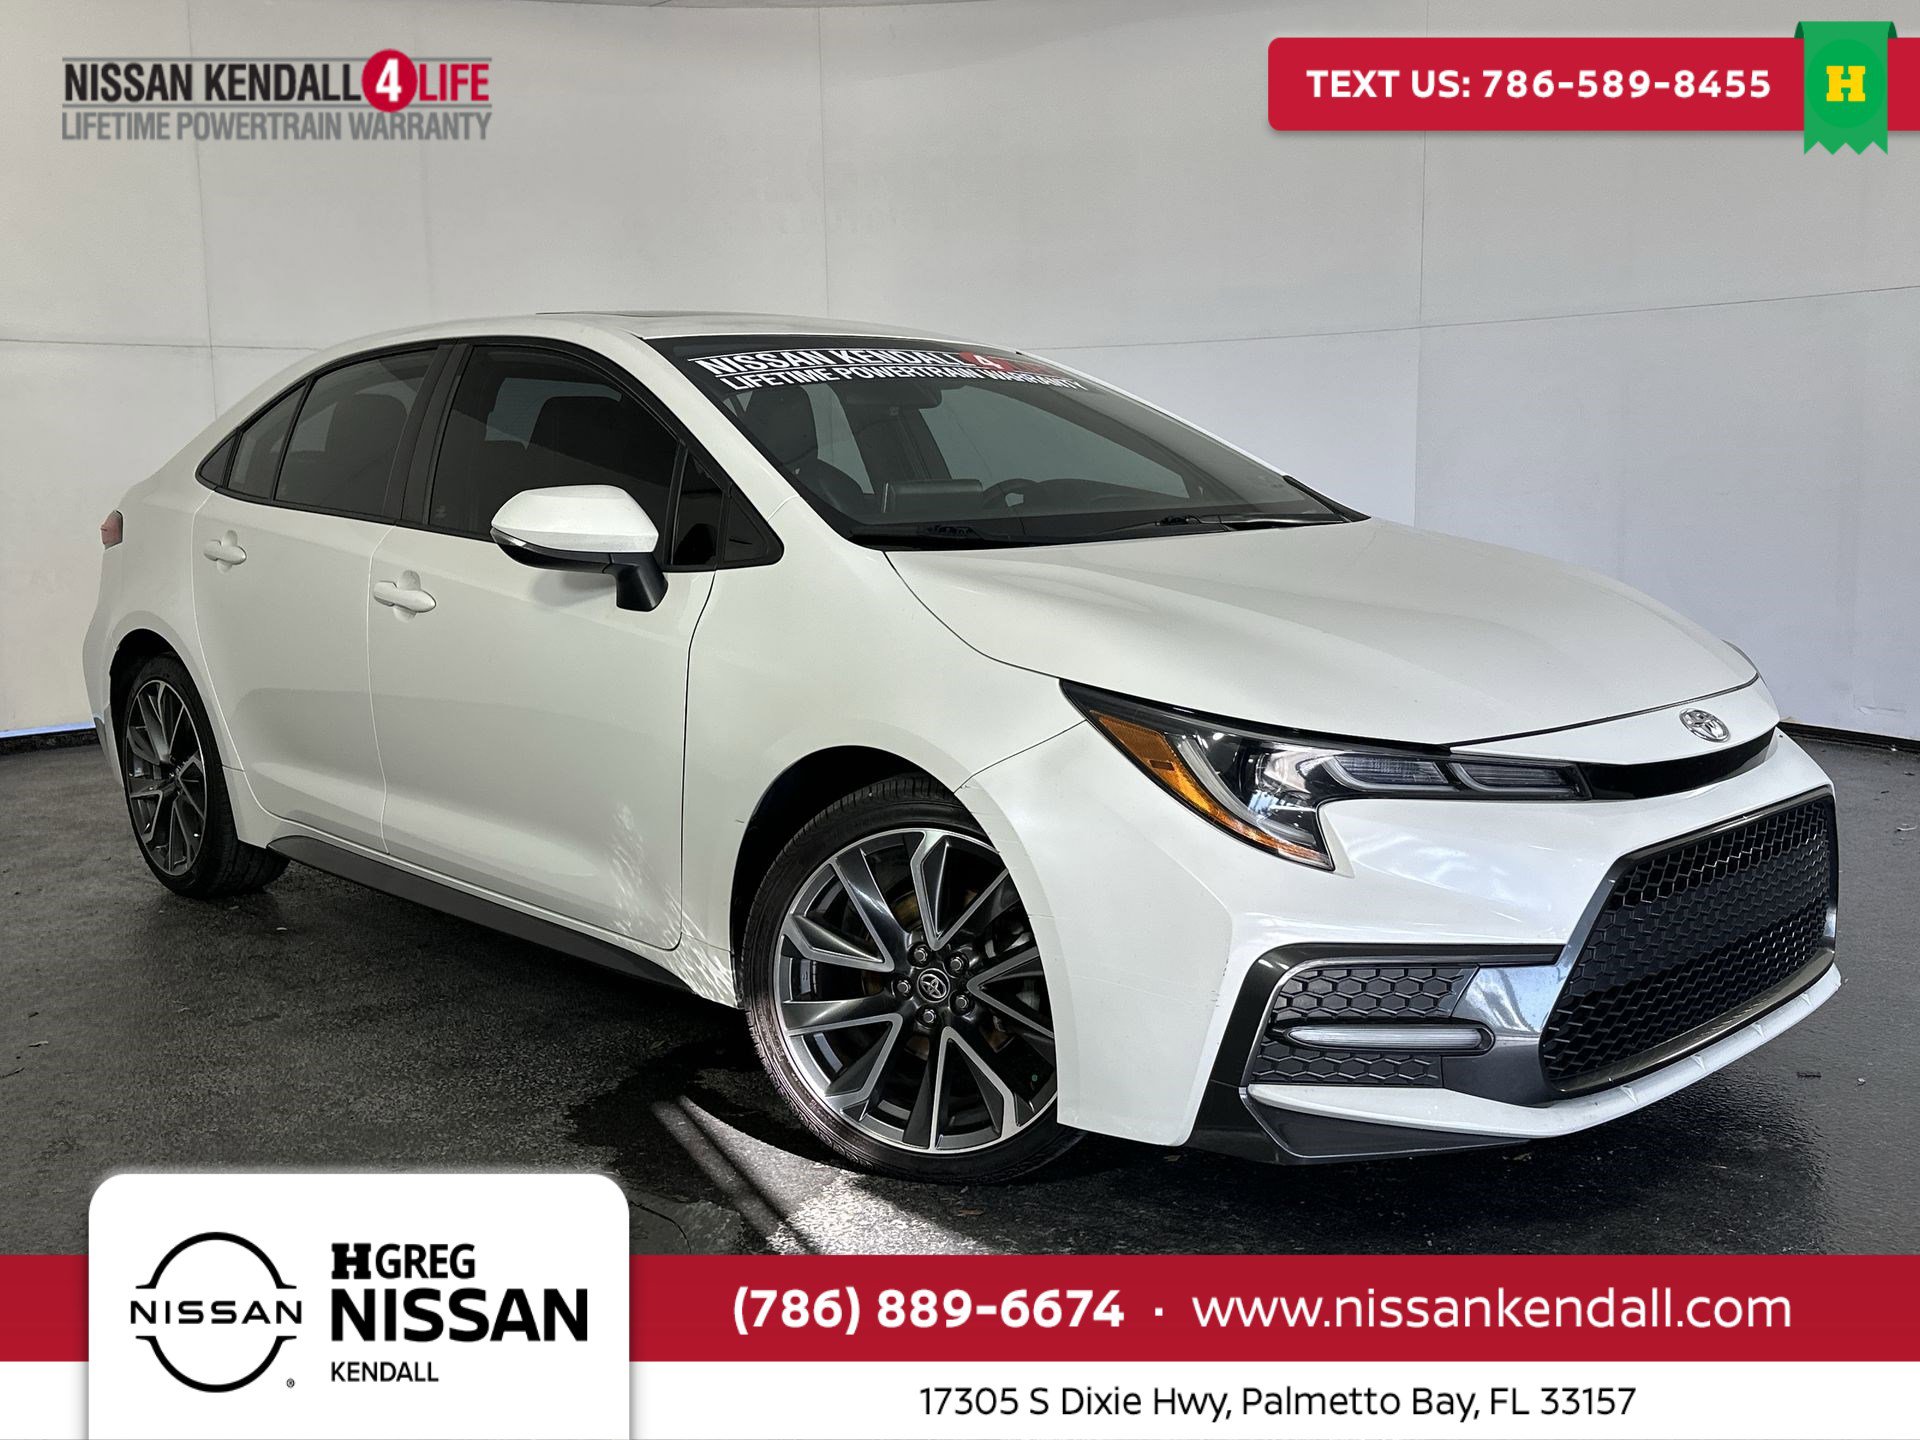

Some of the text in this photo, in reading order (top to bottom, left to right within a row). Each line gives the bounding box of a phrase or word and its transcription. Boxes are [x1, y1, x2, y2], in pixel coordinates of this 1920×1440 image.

[694, 350, 837, 375] NISSAN
[828, 350, 977, 367] KENDALL
[720, 367, 841, 391] LIFETIME
[832, 365, 985, 380] POWERTRAIN
